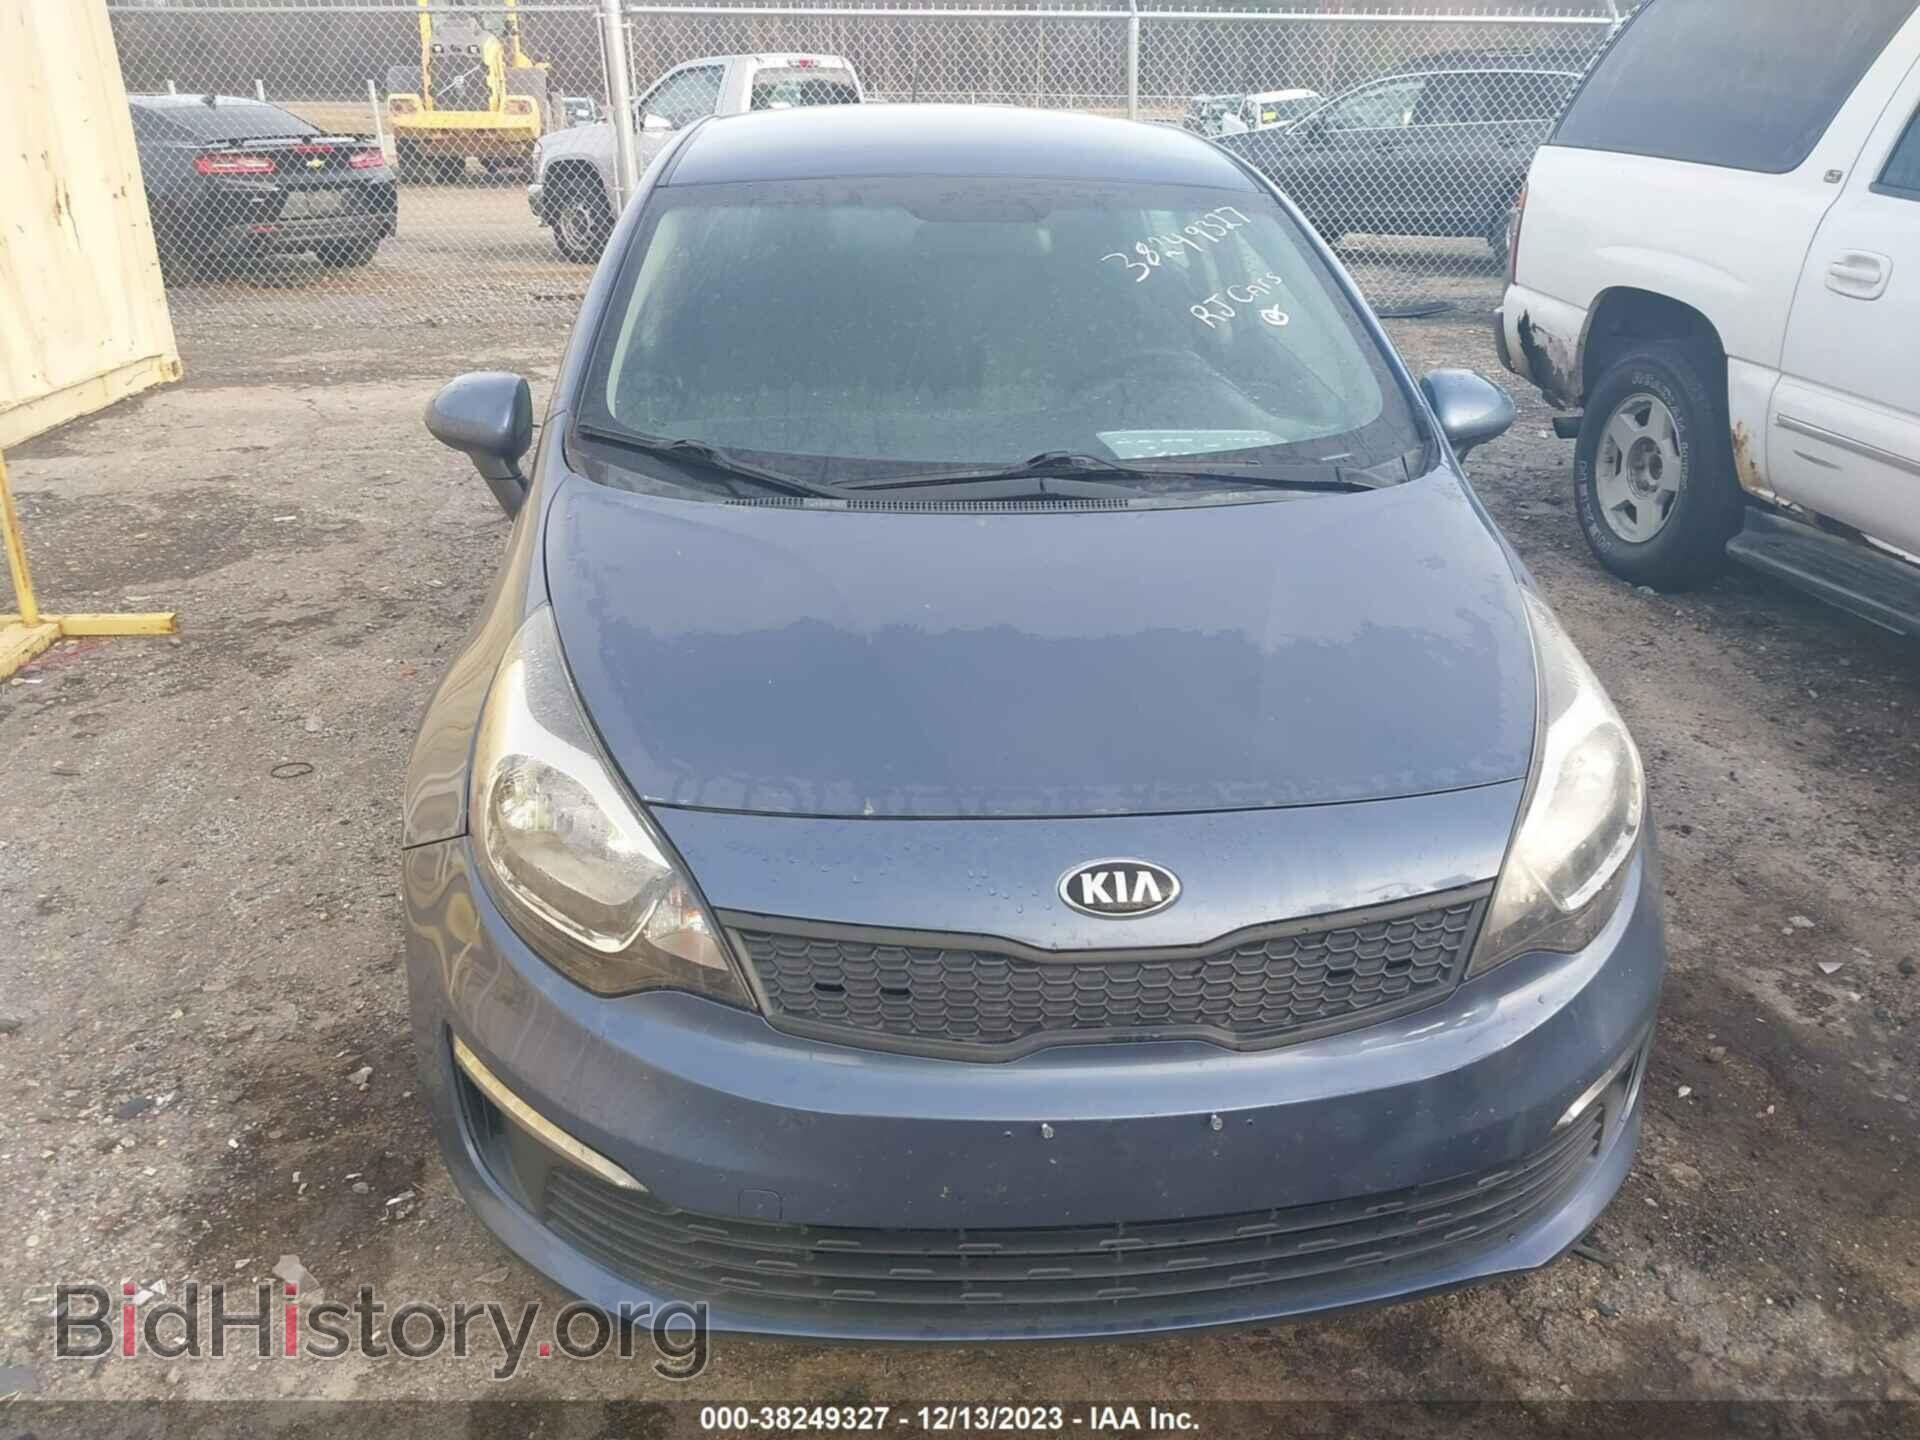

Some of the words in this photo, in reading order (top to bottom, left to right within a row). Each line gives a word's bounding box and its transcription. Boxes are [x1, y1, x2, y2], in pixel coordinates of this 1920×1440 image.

[1101, 206, 1251, 282] 38249327
[1190, 292, 1236, 329] RJ
[1080, 870, 1162, 904] KIA
